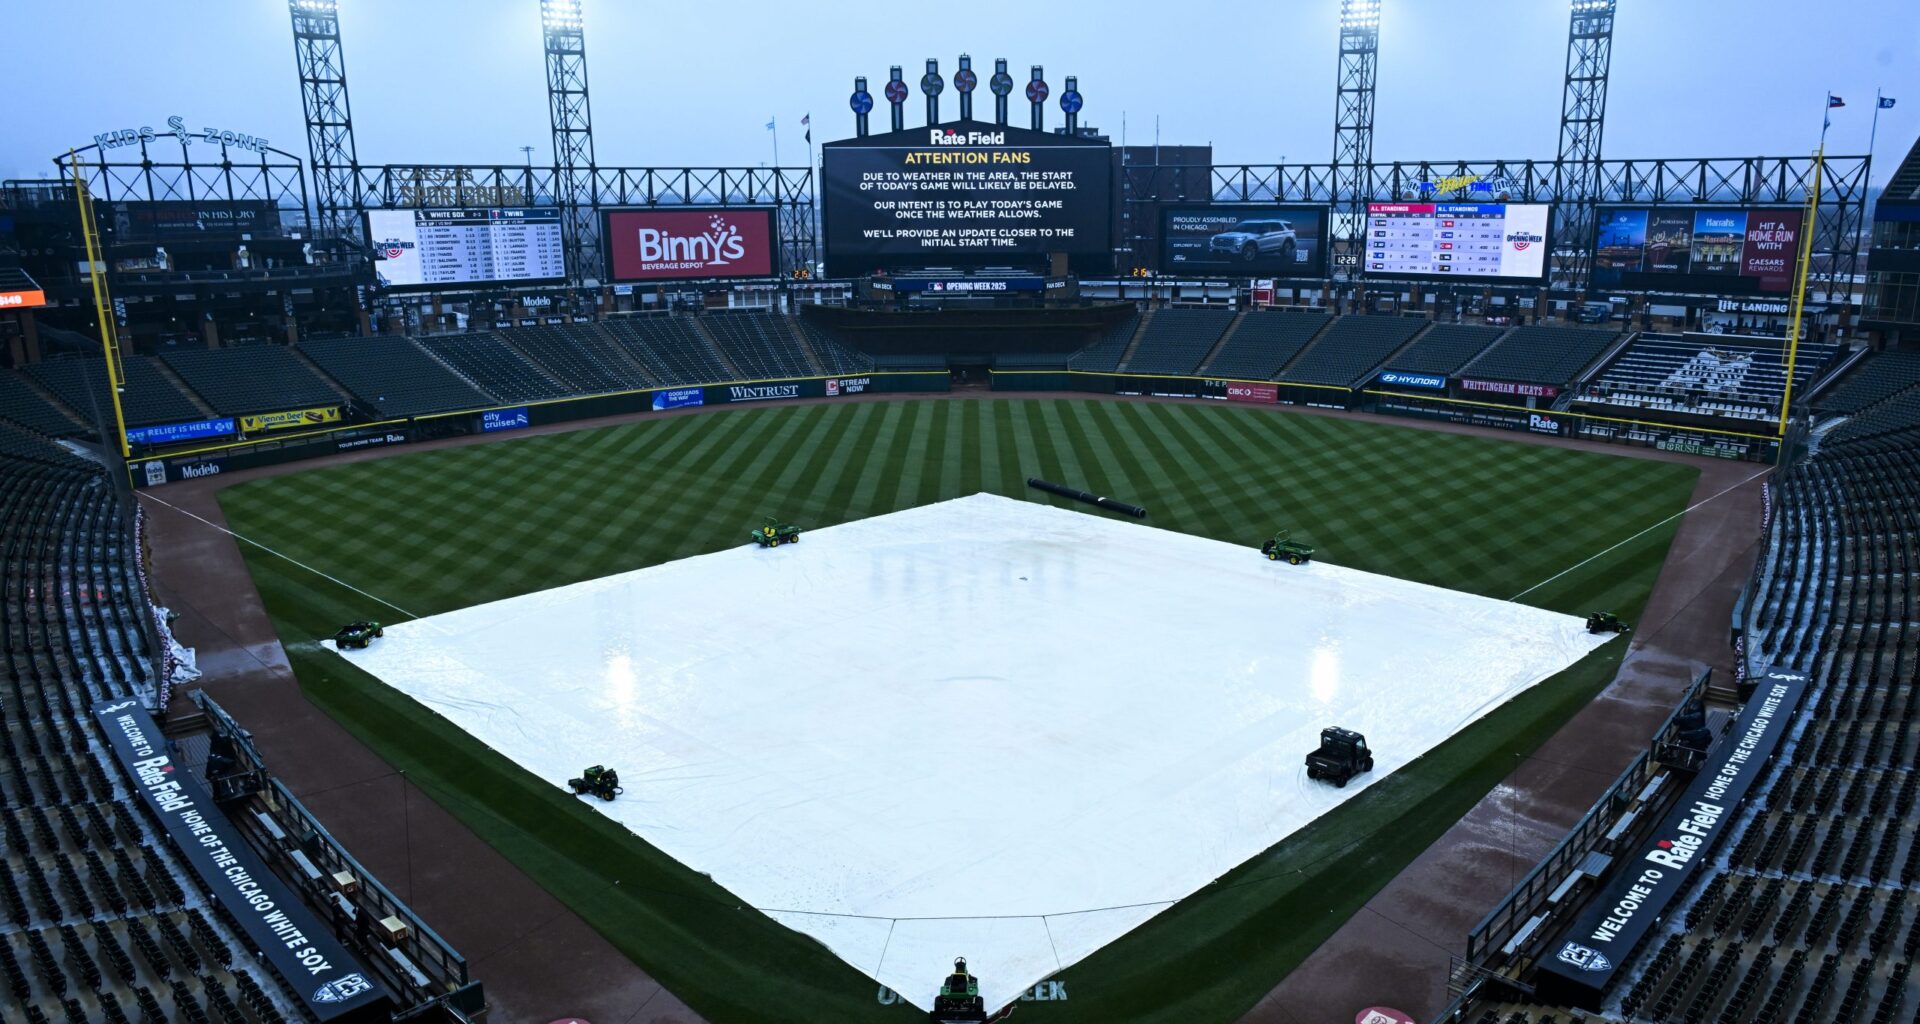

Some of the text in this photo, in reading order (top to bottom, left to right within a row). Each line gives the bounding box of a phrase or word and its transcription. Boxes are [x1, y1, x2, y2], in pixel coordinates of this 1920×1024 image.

[94, 126, 157, 151] KIDS
[203, 127, 269, 154] ZONE
[931, 129, 1004, 145] Rate Field
[905, 152, 1031, 164] ATTENTION FANS
[398, 168, 474, 182] CAESARS
[863, 172, 1072, 182] DUE TO WEATHER IN THE AREA, THE START
[876, 182, 918, 190] TODAY'S
[920, 182, 951, 190] GAME
[952, 182, 976, 190] WILL
[1470, 182, 1493, 191] TIME
[400, 184, 525, 207] SPORTSBOOK
[1760, 222, 1785, 230] HIT A
[1529, 234, 1542, 242] WEEK
[1748, 230, 1794, 242] HOME RUN
[638, 225, 745, 265] Binny's
[1757, 242, 1782, 250] WITH
[642, 262, 704, 270] BEVERAGE DEPOT
[946, 282, 1007, 290] OPENING WEEK 2025
[523, 296, 551, 307] Modelo
[1718, 300, 1788, 313] Lite LANDING
[840, 378, 870, 387] STREAM
[1397, 375, 1440, 386] HYUNDAI
[730, 384, 798, 398] WINTRUST
[846, 385, 864, 393] NOW
[1228, 388, 1244, 396] CIBC
[1462, 379, 1515, 394] WHITTINGHAM
[1517, 384, 1543, 396] MEATS
[258, 412, 285, 424] Vienna
[287, 410, 304, 421] Beef
[484, 412, 500, 423] city
[1530, 414, 1558, 430] Rate
[484, 418, 515, 429] cruises
[148, 426, 177, 438] RELIEF
[189, 422, 212, 432] HERE
[386, 434, 405, 442] Rate
[1674, 444, 1700, 454] RUSH
[182, 463, 220, 479] Modelo
[1590, 684, 1789, 944] WELCOME TO Rate Field HOME OF THE CHICAGO WHITE SOX
[116, 714, 333, 976] WELCOME TO Rate Field HOME OF THE CHICAGO WHITE SOX
[1556, 942, 1591, 966] 125
[331, 972, 374, 999] 125
